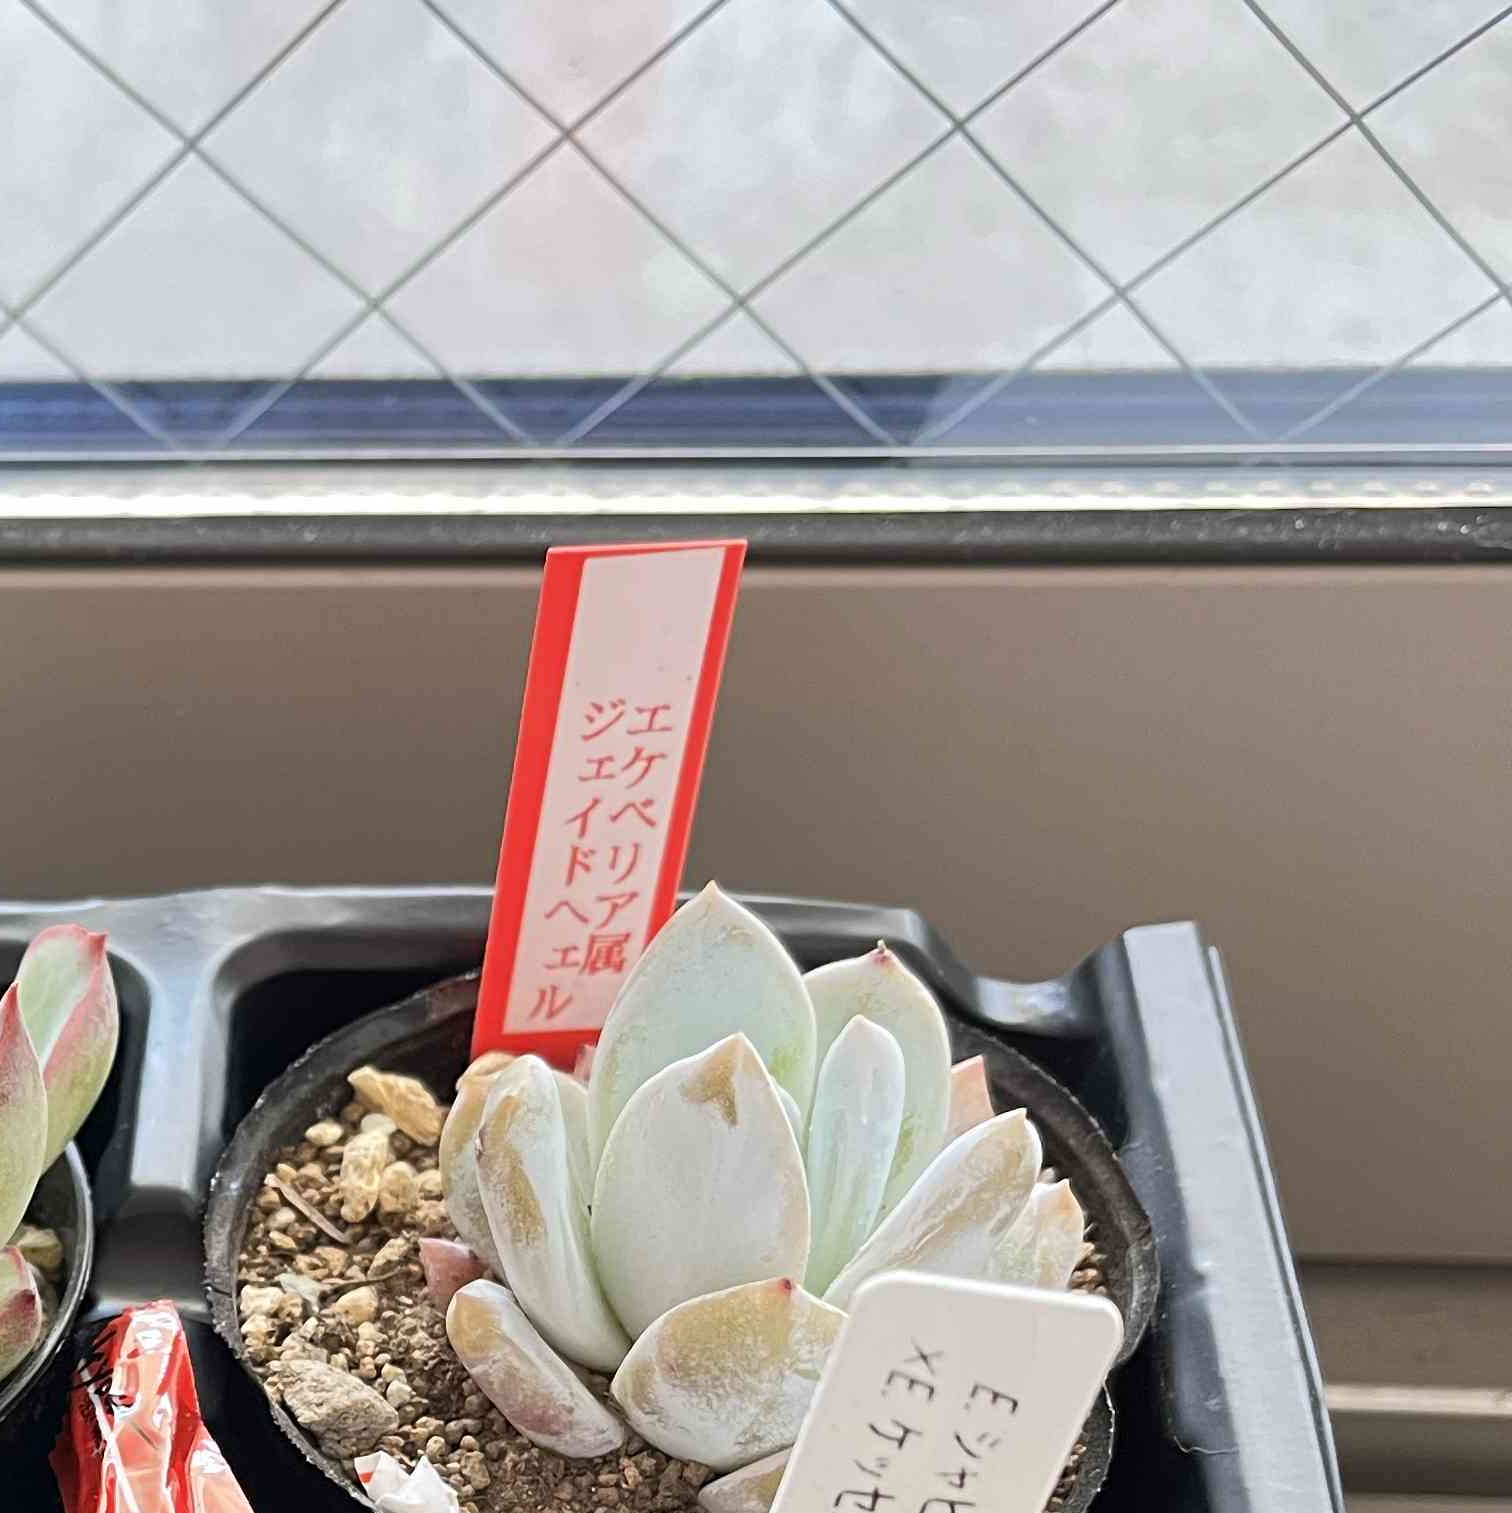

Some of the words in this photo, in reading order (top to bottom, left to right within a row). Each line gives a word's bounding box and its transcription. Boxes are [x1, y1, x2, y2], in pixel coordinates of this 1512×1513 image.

[579, 703, 674, 976] エケベリア属
